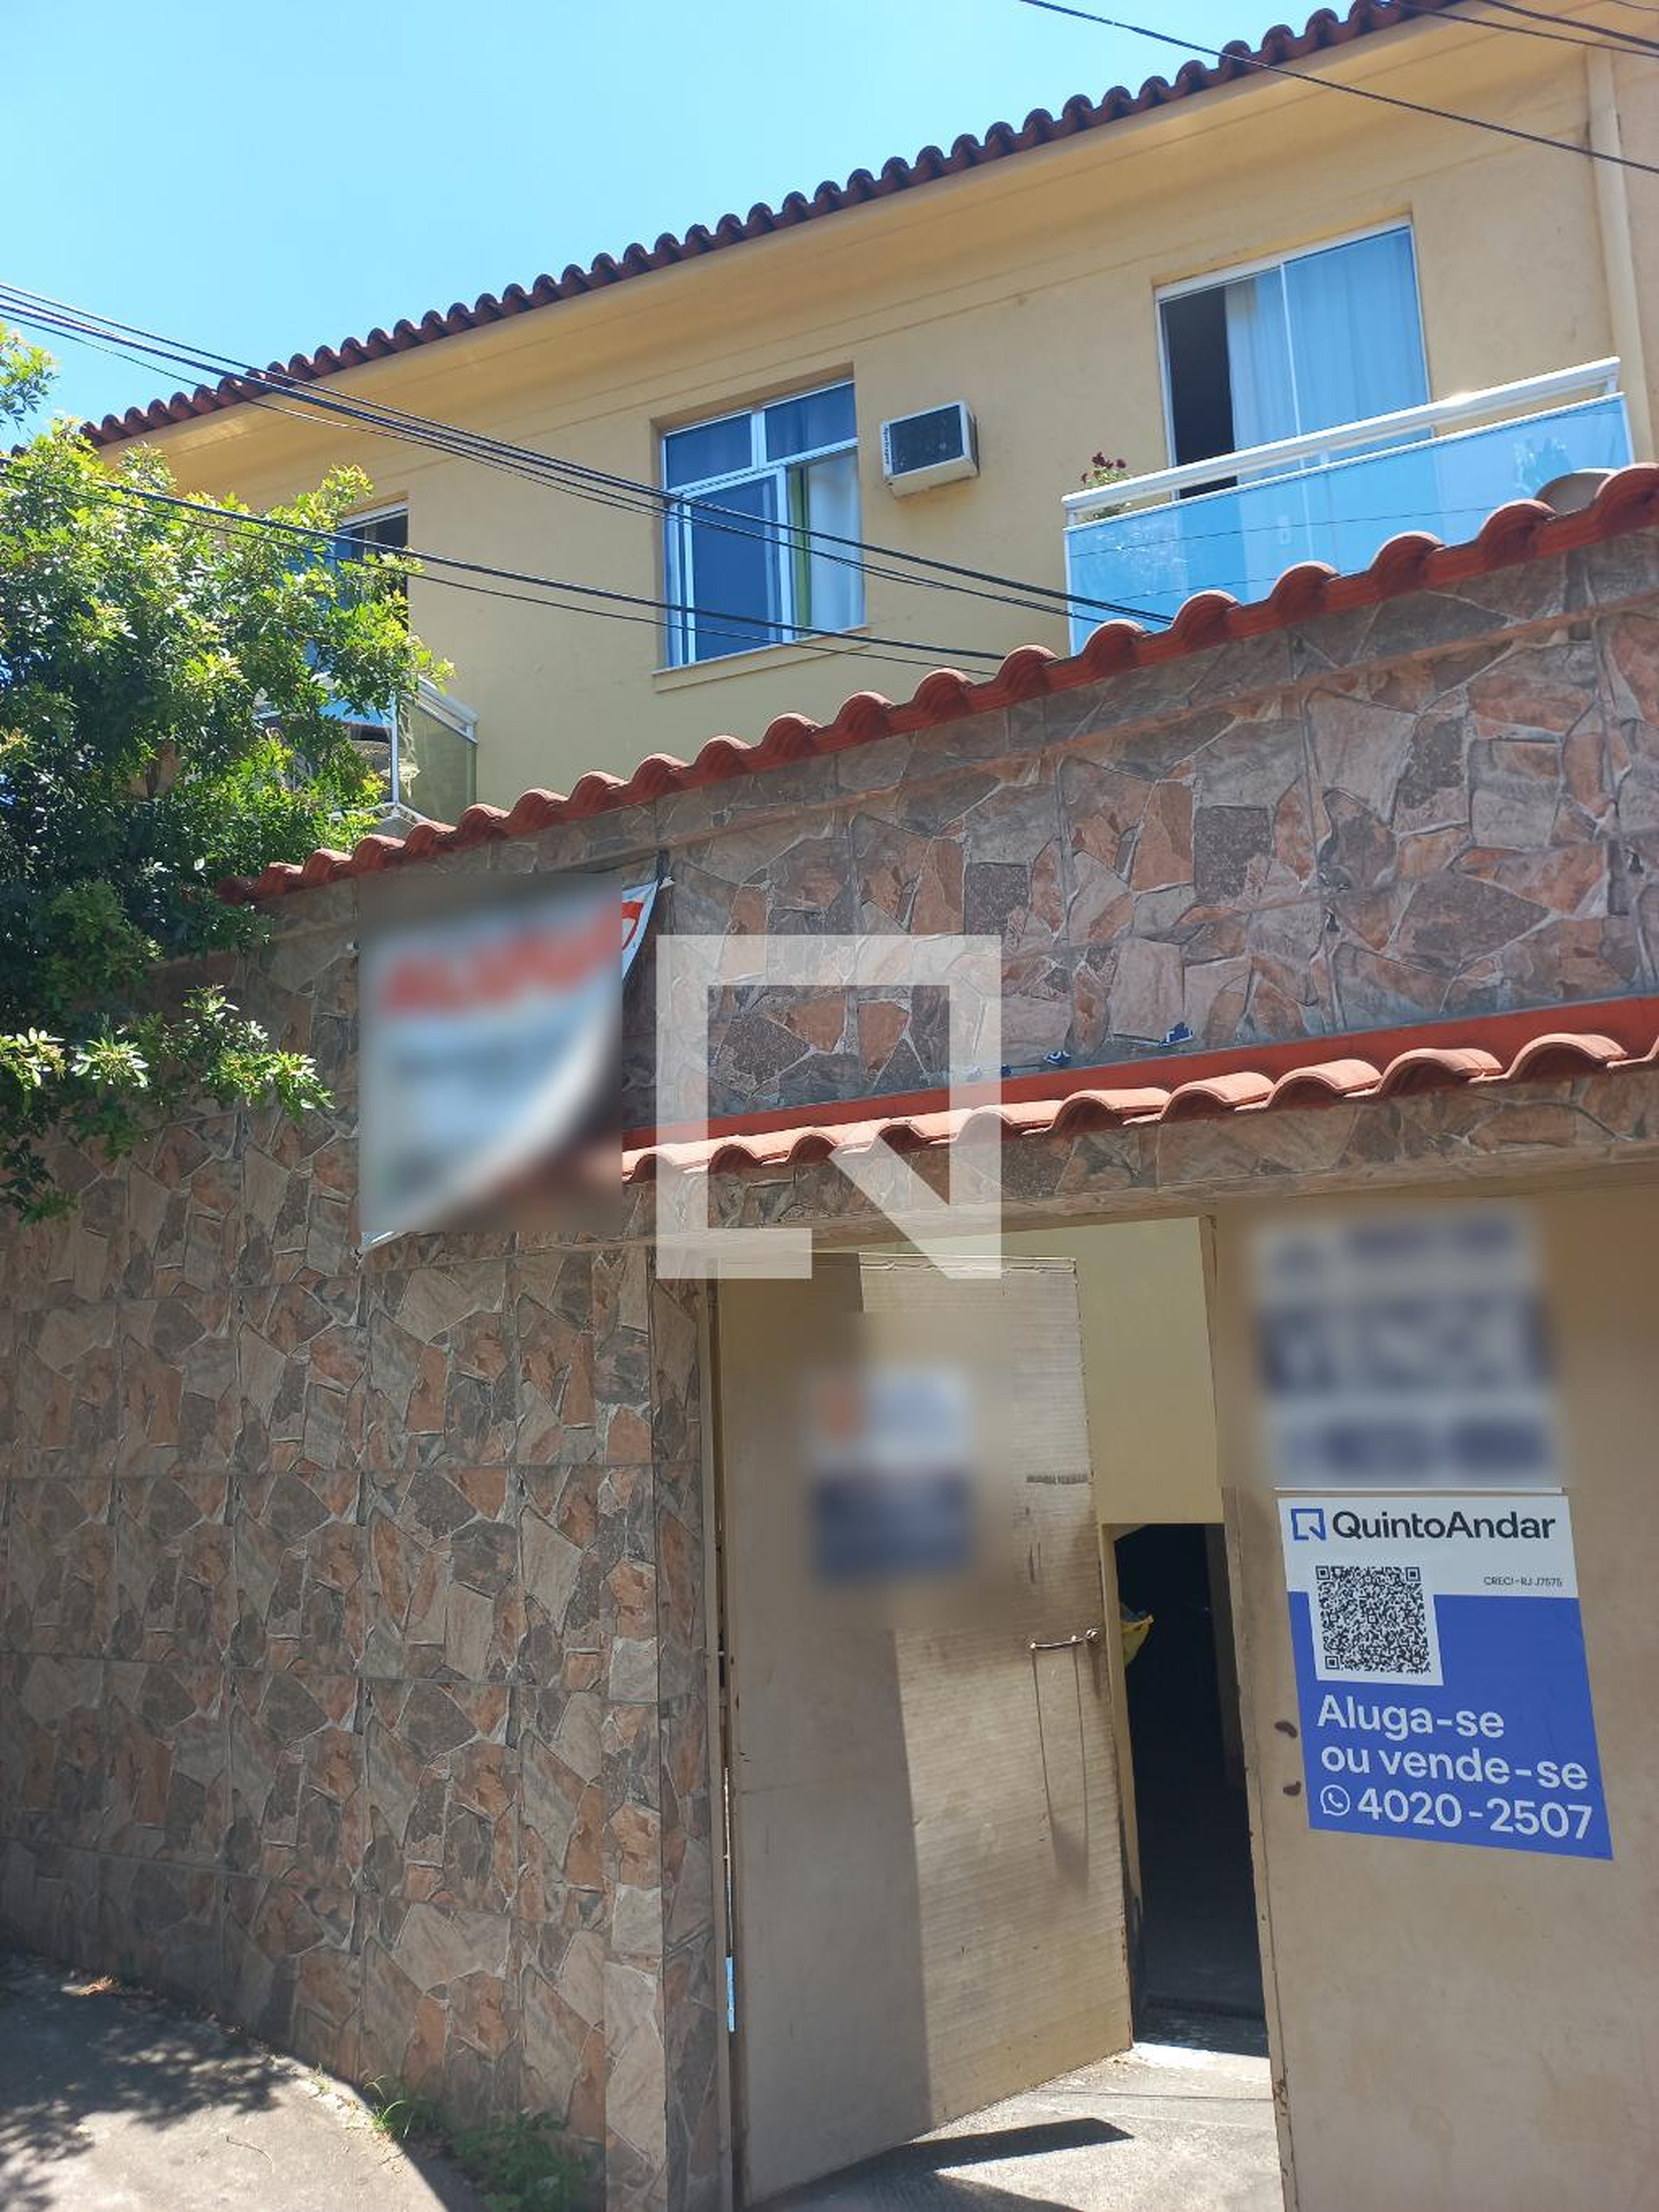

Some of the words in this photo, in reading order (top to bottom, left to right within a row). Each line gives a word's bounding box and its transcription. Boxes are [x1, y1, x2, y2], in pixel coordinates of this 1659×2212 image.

[1332, 1511, 1556, 1540] QuintoAndar
[1317, 1694, 1504, 1741] Aluga-se
[1321, 1746, 1370, 1773] ou
[1379, 1747, 1588, 1790] vende-se
[1357, 1788, 1592, 1840] 4020-2507
